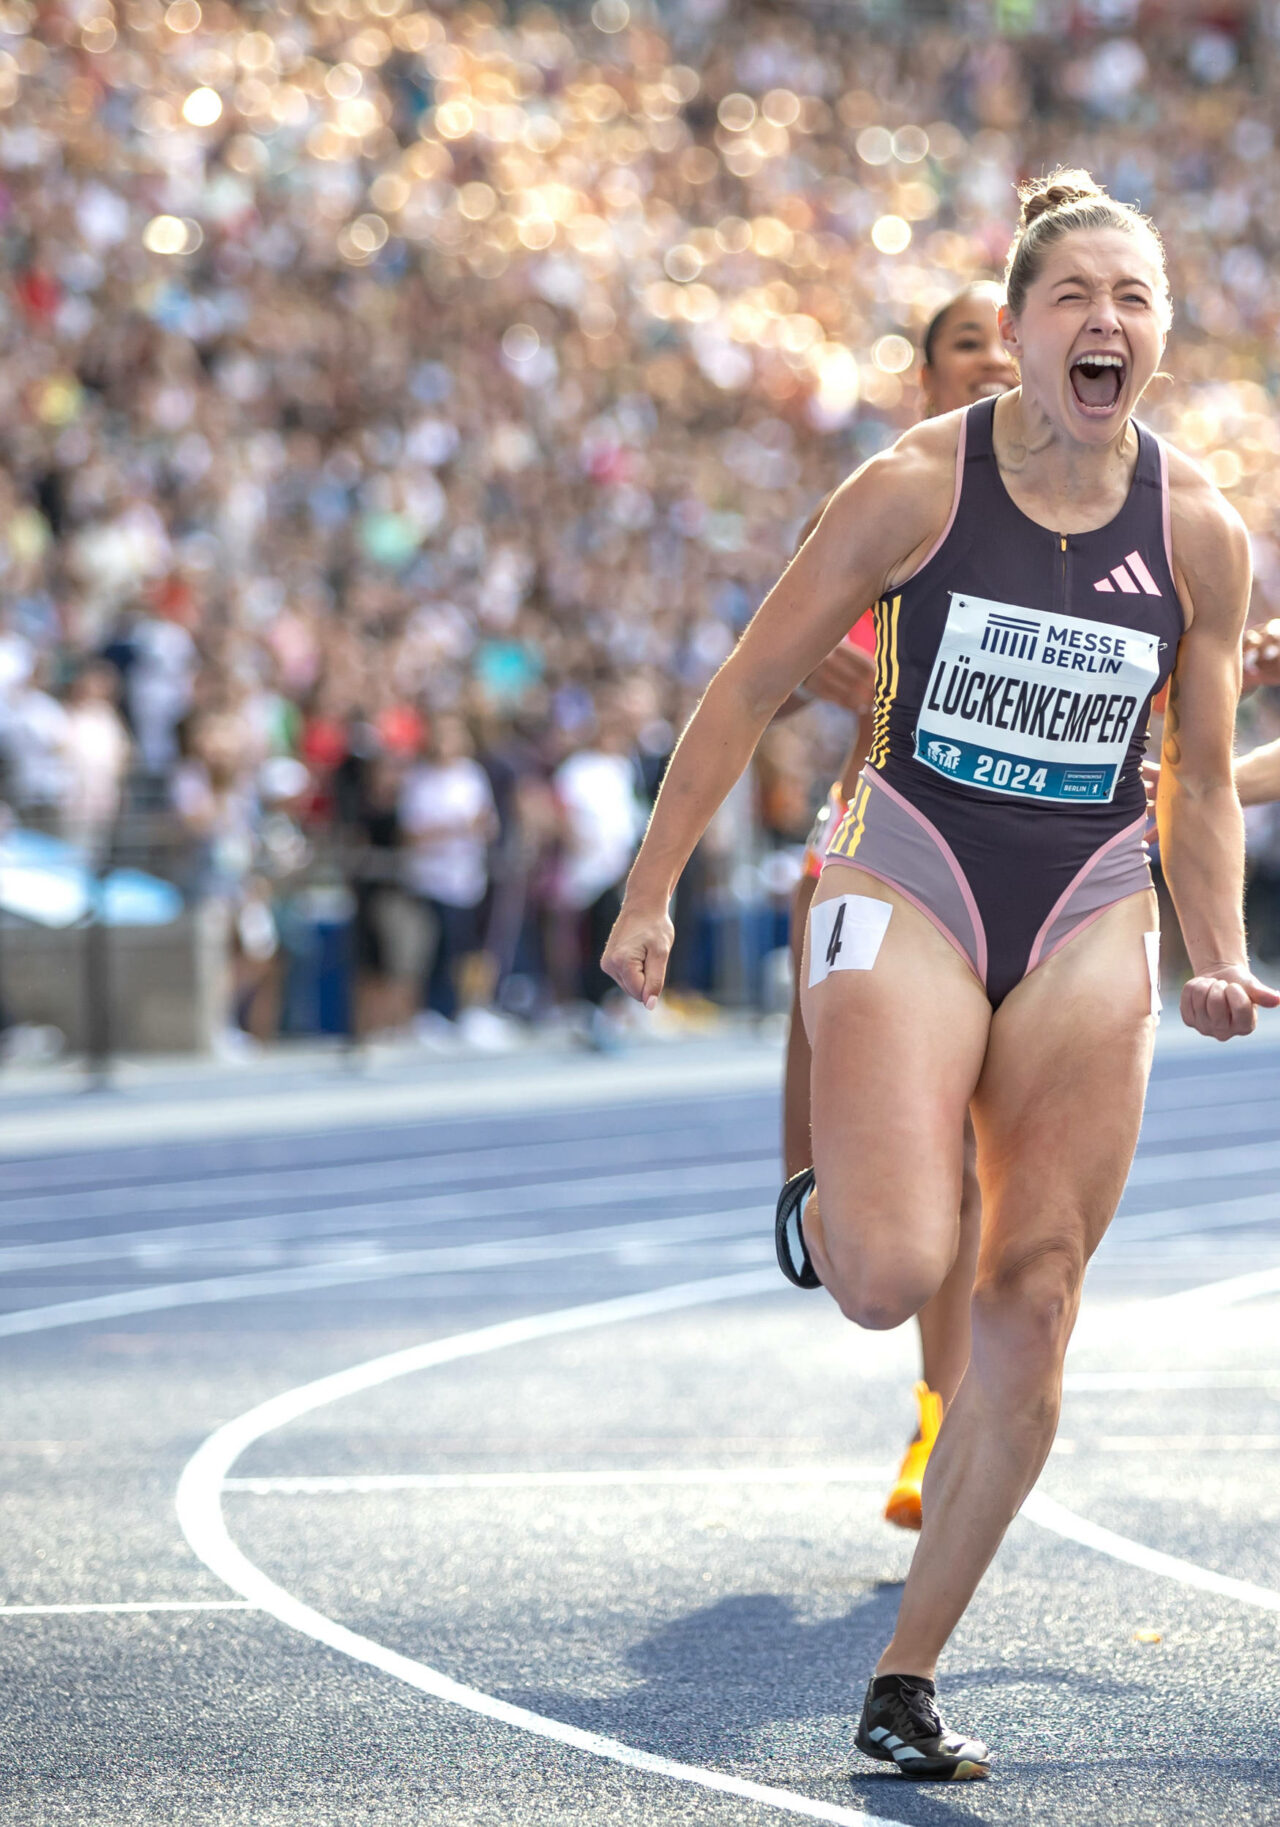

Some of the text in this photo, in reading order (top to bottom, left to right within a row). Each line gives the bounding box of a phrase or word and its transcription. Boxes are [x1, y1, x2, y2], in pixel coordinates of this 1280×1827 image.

[1047, 625, 1127, 658] MESSE
[1041, 647, 1123, 674] BERLIN
[927, 655, 1137, 744] LÜCKENKEMPER
[927, 747, 960, 770] ISTAF
[973, 755, 1048, 792] 2024
[1063, 784, 1087, 792] BERLIN
[826, 902, 847, 967] 4
